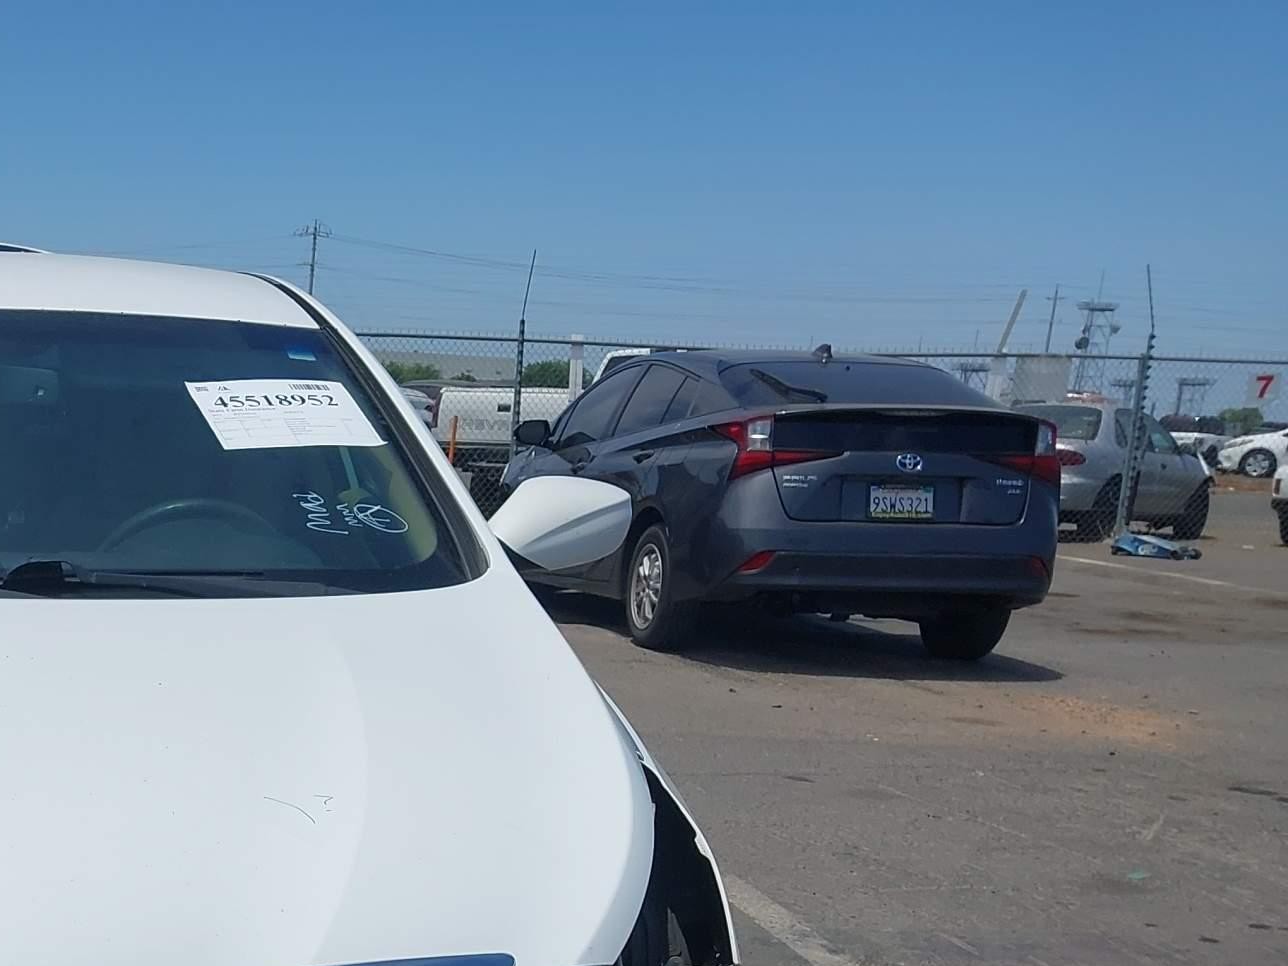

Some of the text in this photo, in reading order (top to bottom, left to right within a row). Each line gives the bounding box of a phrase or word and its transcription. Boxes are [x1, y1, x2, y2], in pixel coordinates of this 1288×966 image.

[1256, 375, 1274, 398] 7
[214, 393, 339, 409] 45518952
[872, 496, 929, 513] 9SWS321
